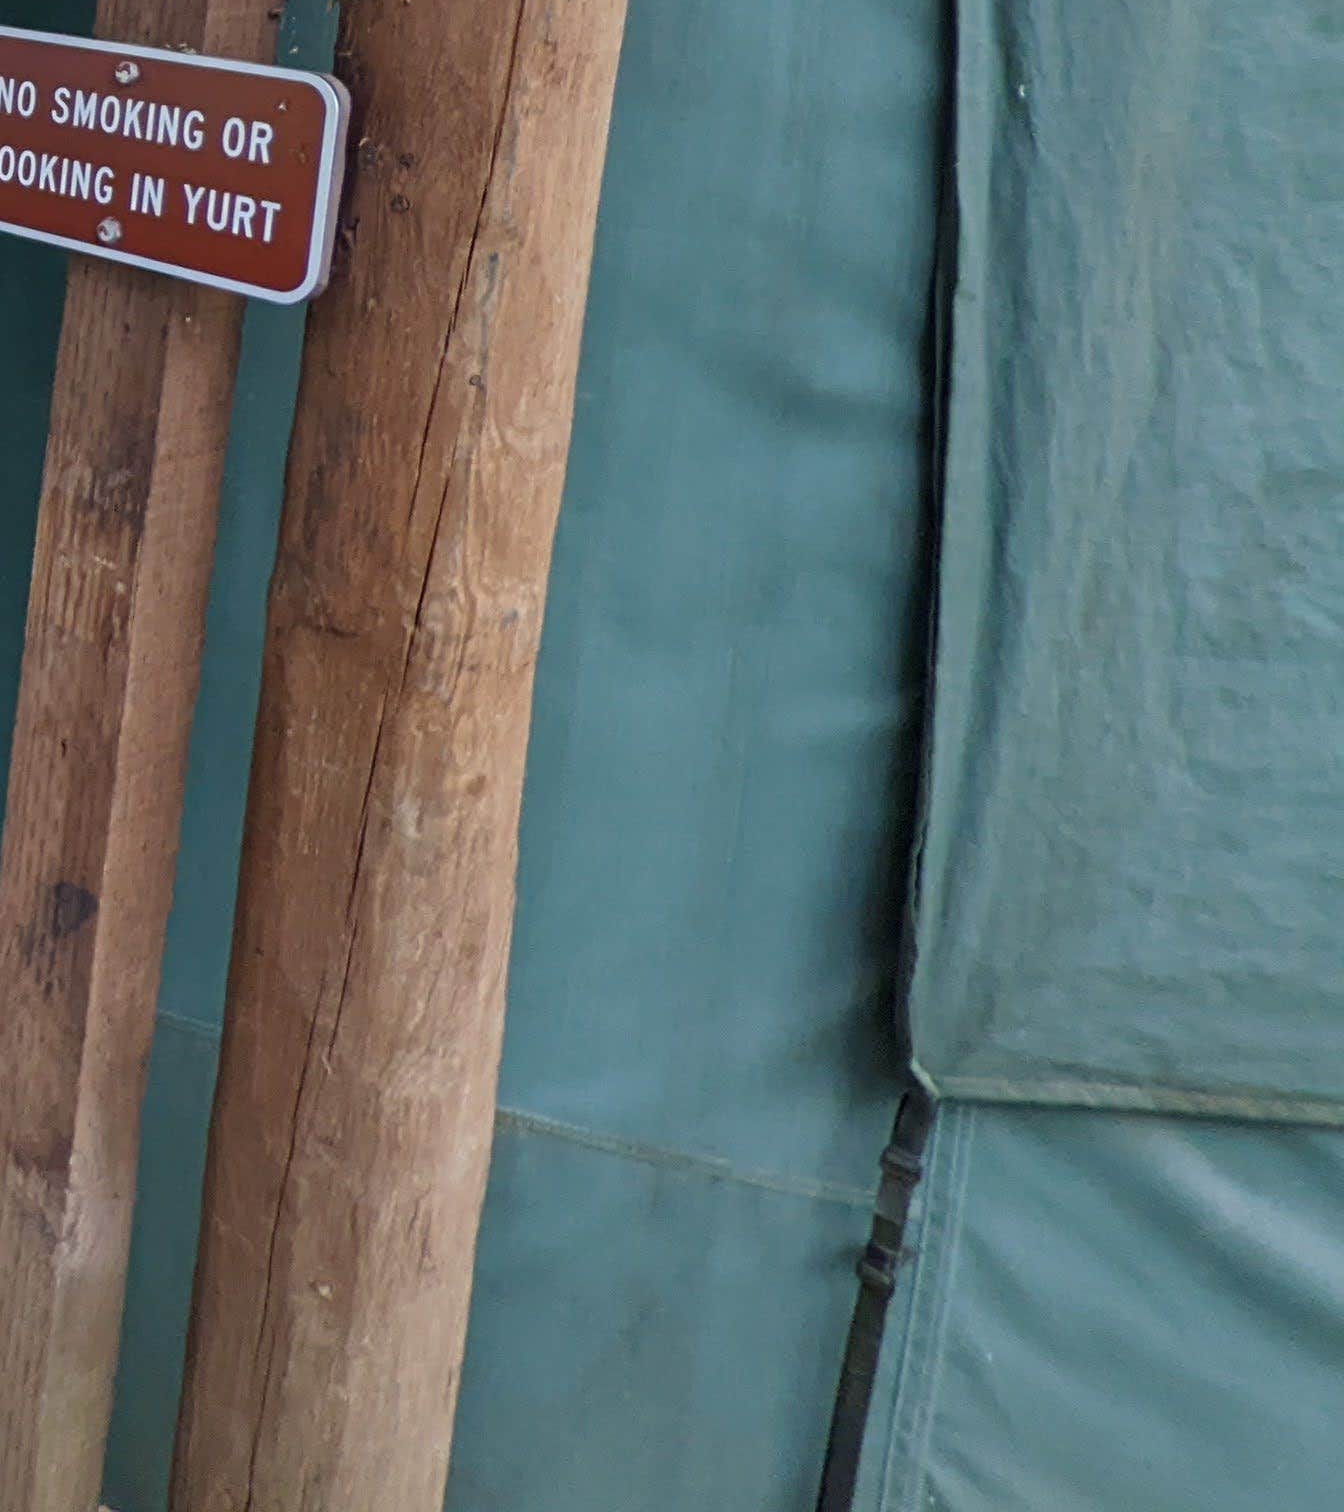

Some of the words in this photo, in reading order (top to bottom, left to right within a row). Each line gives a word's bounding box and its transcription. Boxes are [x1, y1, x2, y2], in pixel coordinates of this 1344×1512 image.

[51, 87, 205, 151] SMOKING
[222, 117, 274, 164] OR
[130, 172, 165, 217] IN
[183, 184, 282, 243] YURT
